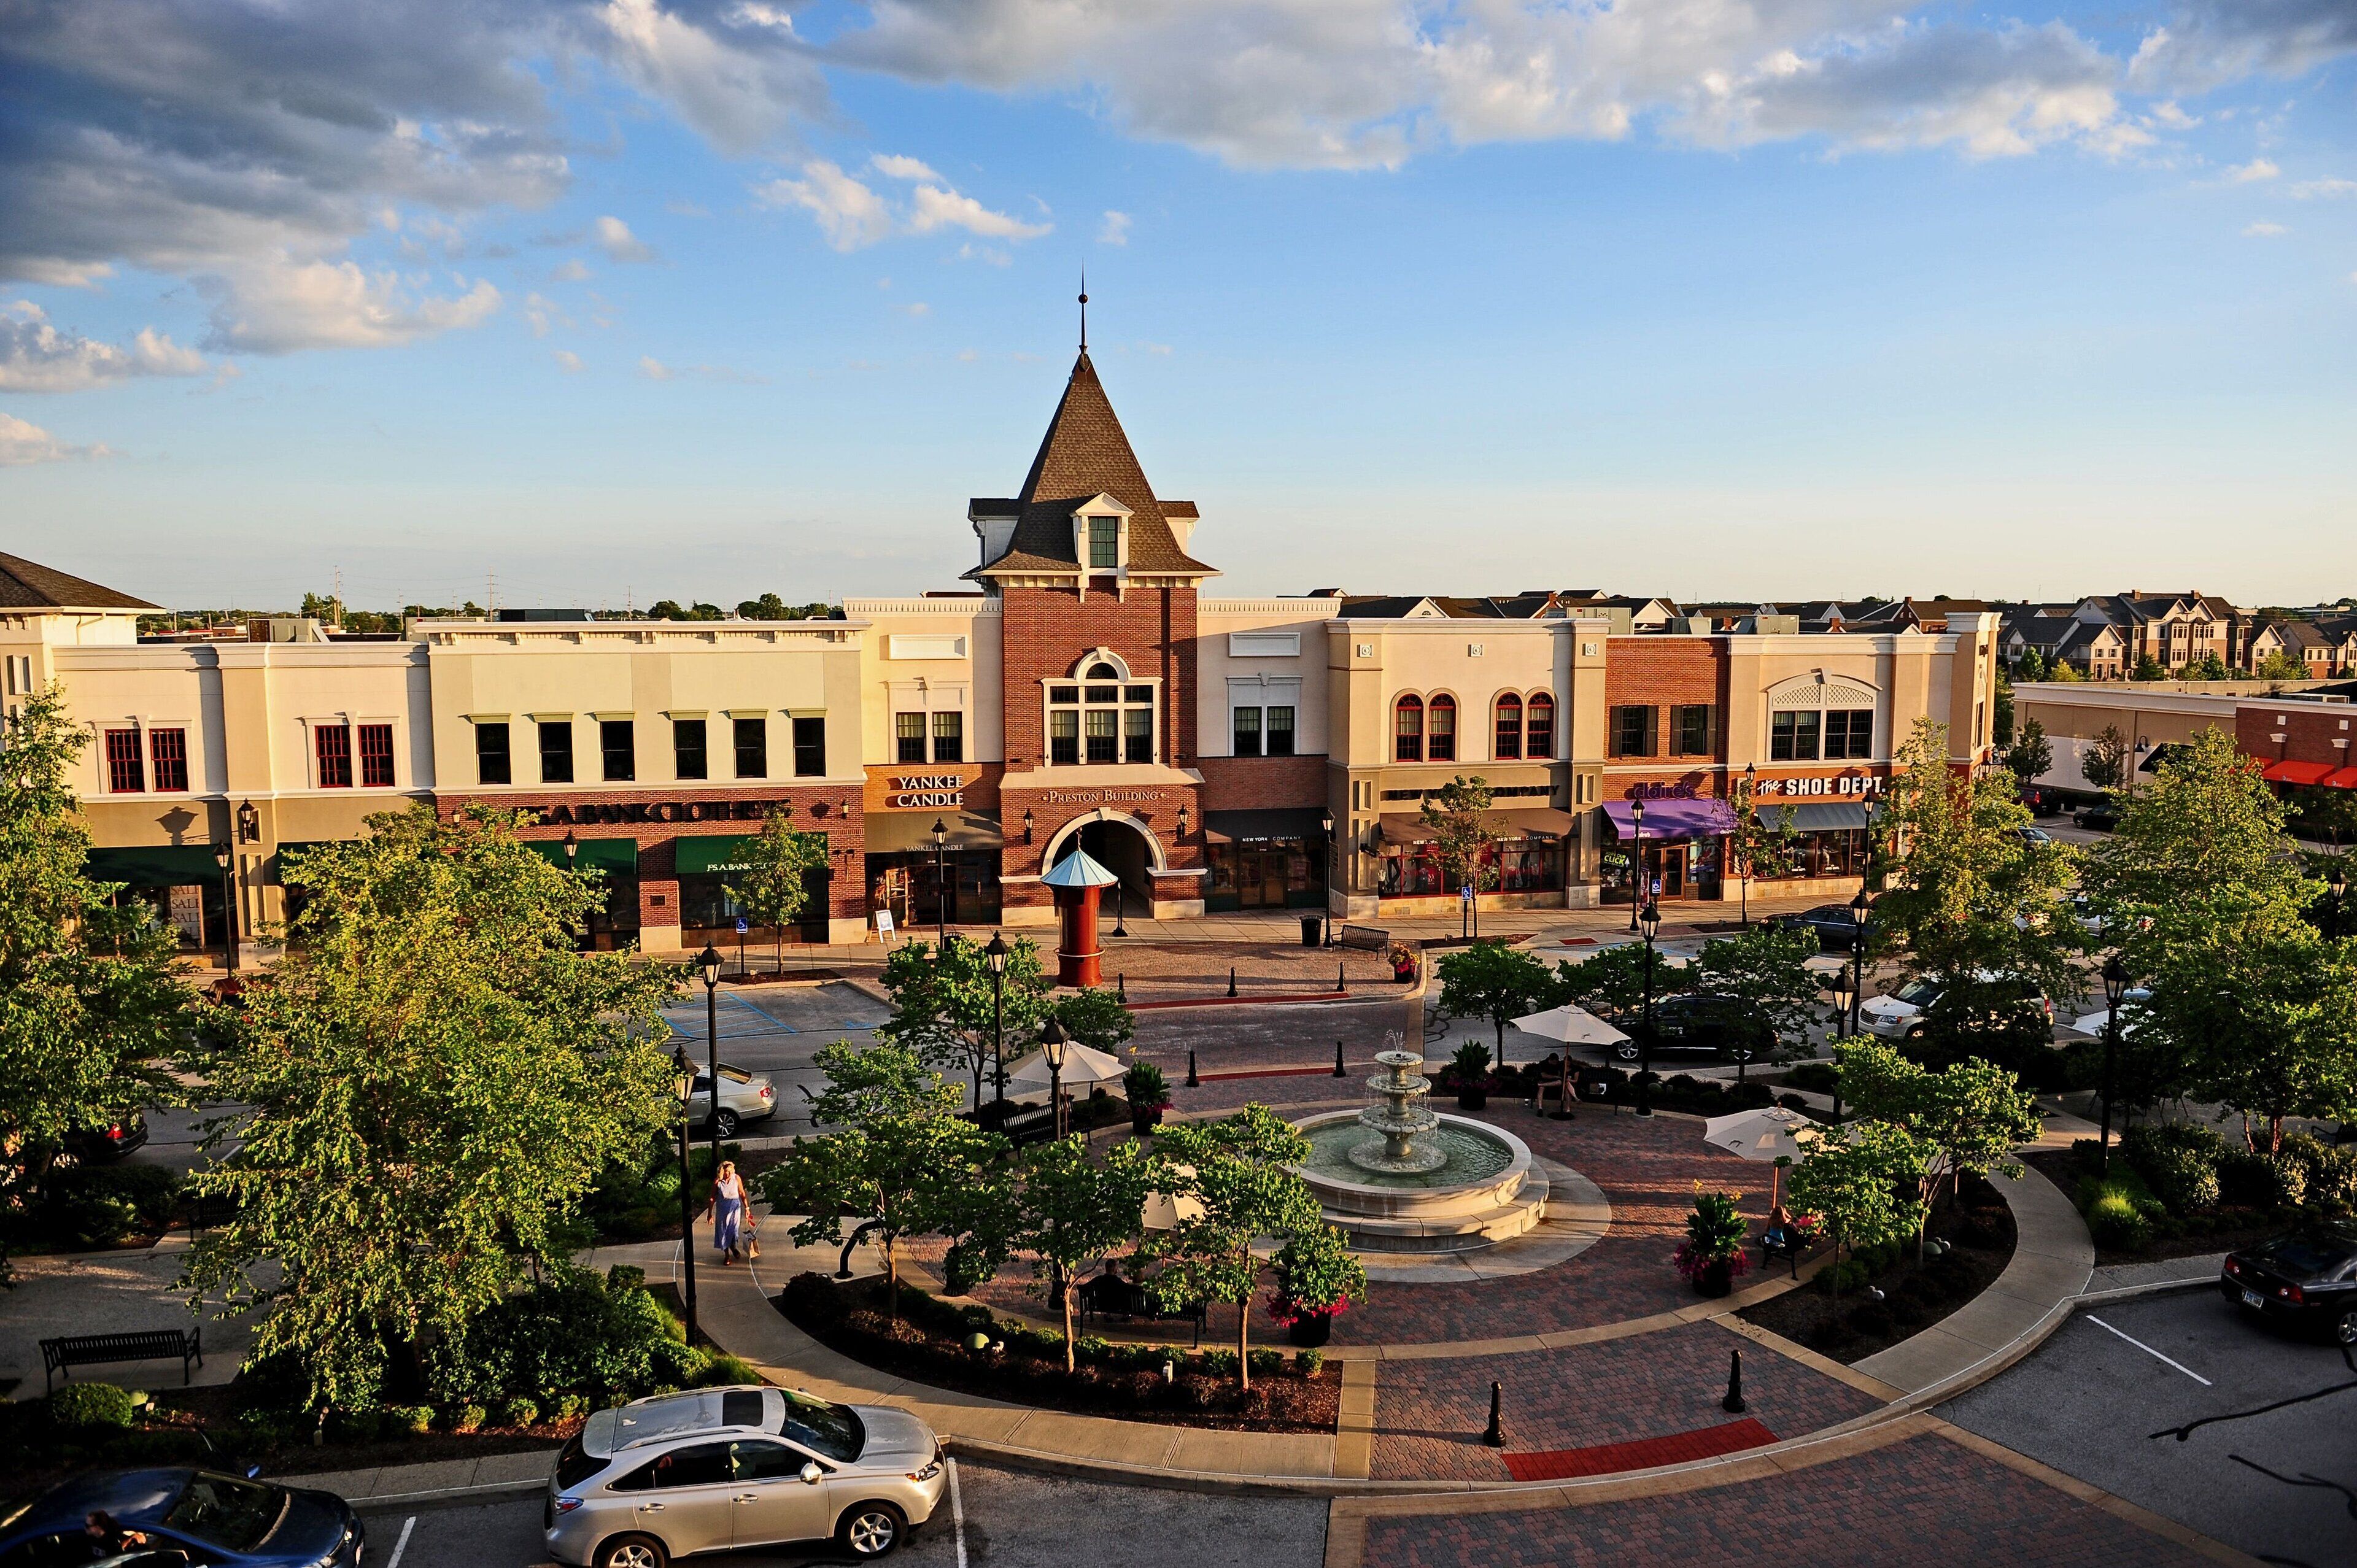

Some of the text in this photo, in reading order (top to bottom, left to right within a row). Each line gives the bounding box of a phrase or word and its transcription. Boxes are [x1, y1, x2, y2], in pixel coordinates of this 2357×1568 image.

[899, 775, 963, 790] YANKEE
[1634, 781, 1695, 798] claire's
[1757, 776, 1886, 796] the SHOE DEPT.
[1490, 785, 1560, 797] OMPANY
[897, 792, 964, 807] CANDLE
[1604, 855, 1625, 865] CLICK
